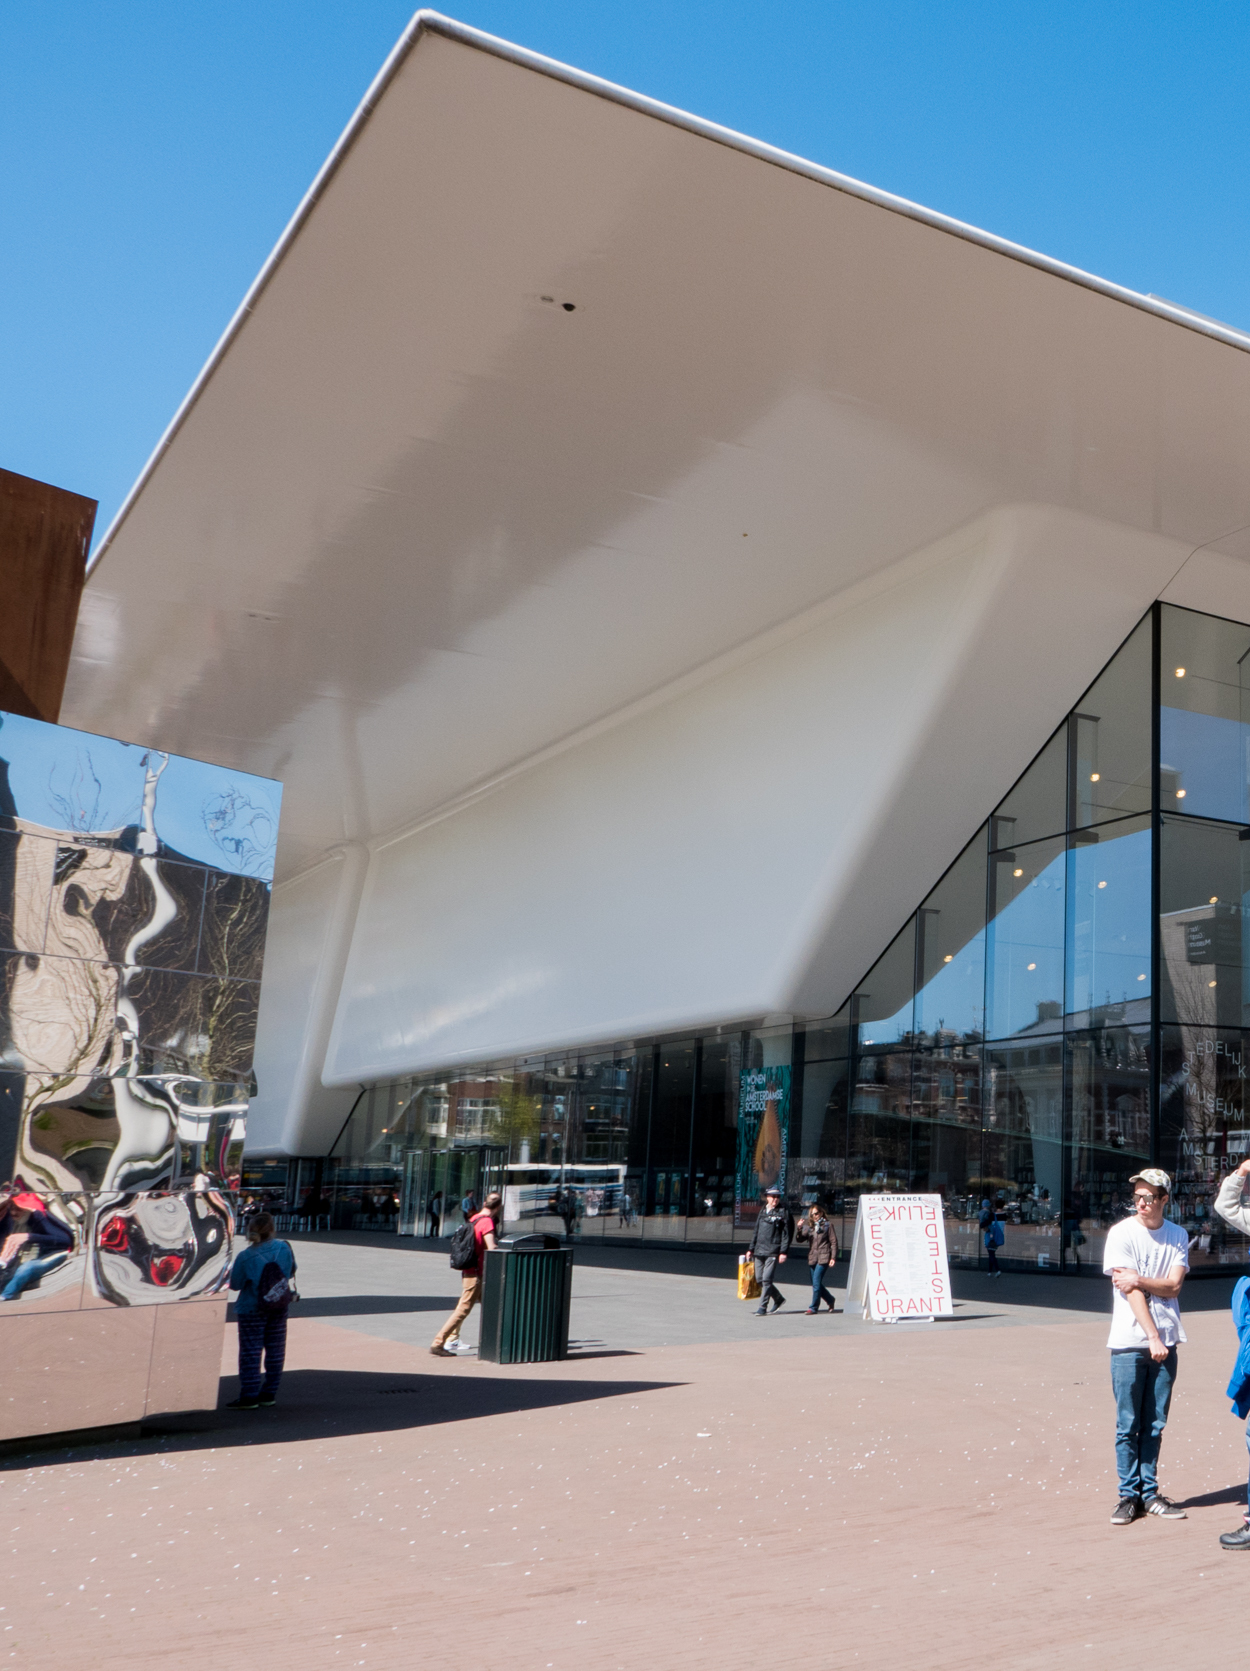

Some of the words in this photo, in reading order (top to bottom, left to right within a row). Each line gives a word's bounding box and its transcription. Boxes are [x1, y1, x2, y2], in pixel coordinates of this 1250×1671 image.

[1182, 1040, 1246, 1078] STEDELIJK
[745, 1101, 767, 1112] SCHOOL
[1186, 1083, 1244, 1121] MUSEUM
